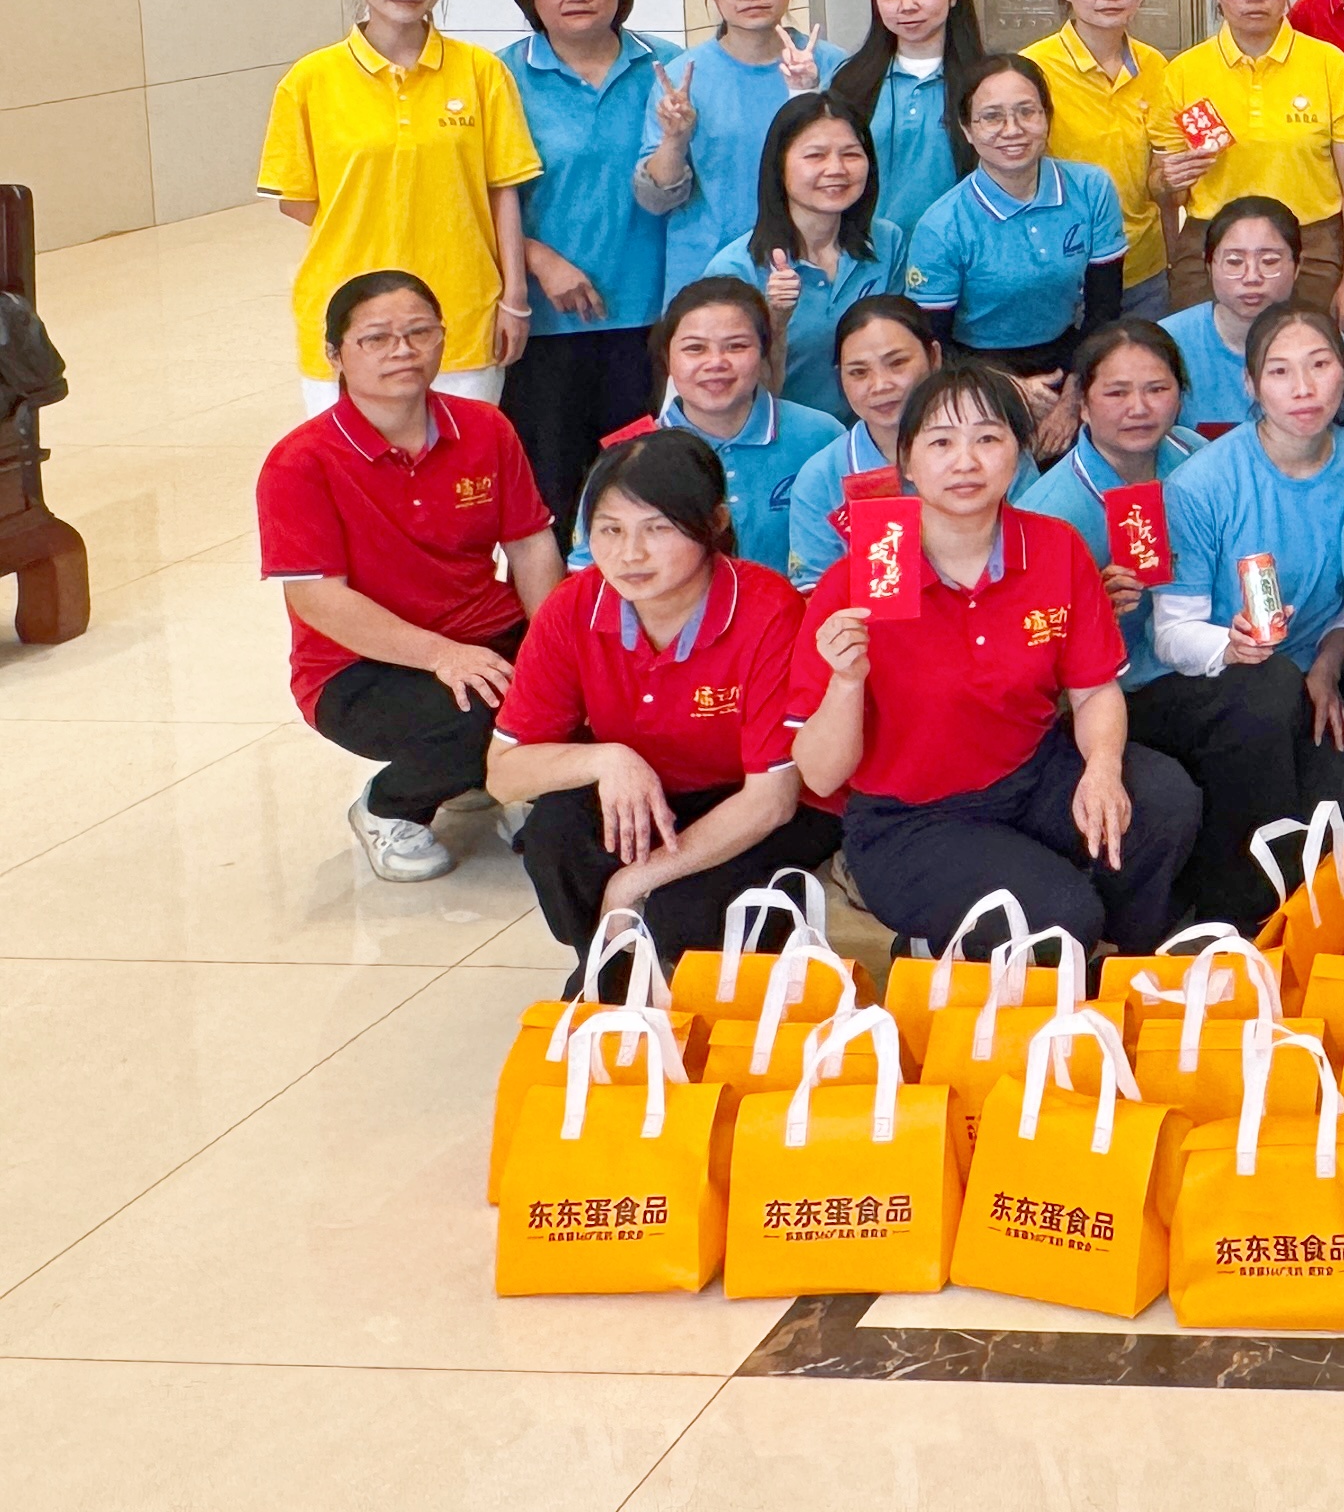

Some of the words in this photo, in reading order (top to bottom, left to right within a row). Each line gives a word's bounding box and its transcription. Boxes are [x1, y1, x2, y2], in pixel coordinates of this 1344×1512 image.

[528, 1195, 668, 1230] 东东蛋食品
[762, 1194, 912, 1230] 东东蛋食品
[989, 1191, 1115, 1243] 东东蛋食品
